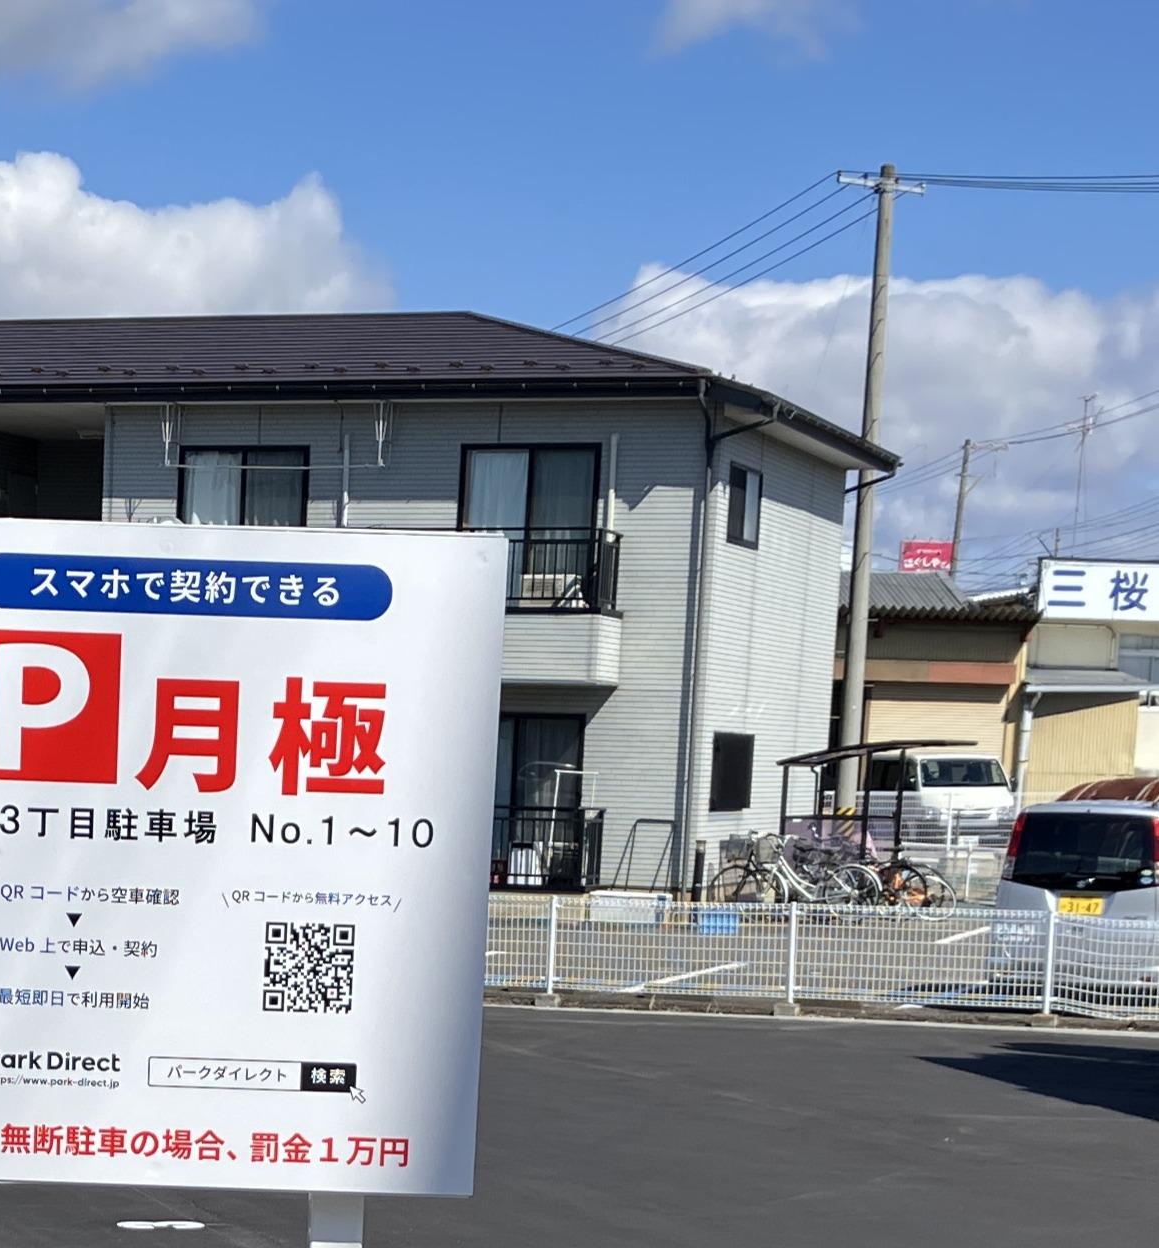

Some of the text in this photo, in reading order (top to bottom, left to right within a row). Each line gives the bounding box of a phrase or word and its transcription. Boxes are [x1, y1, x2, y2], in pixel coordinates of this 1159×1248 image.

[31, 567, 341, 606] スマホで契約できる
[1047, 570, 1148, 611] 三桜
[135, 677, 386, 795] 月極
[47, 1052, 120, 1072] Direct
[168, 1065, 287, 1082] パークダイレクト
[311, 1068, 345, 1084] 検索
